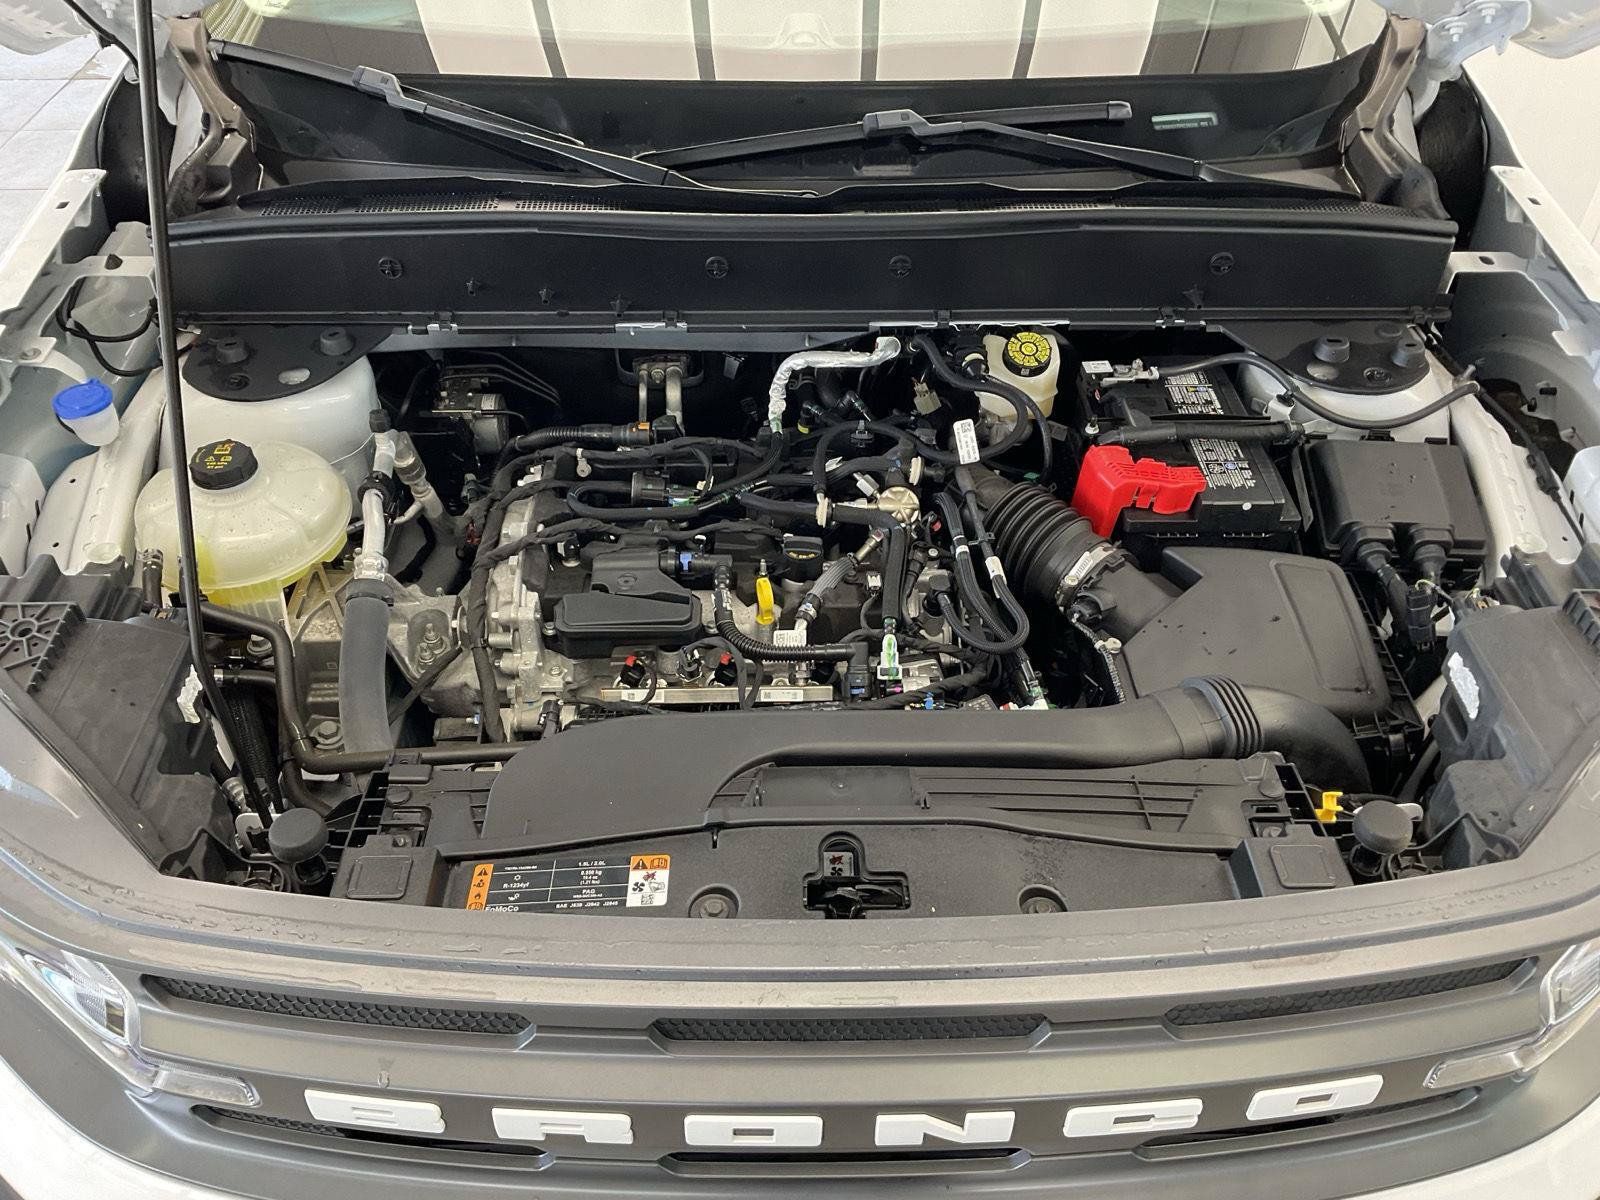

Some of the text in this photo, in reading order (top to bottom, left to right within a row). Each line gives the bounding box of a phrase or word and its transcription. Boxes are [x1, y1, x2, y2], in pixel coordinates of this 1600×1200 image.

[502, 881, 530, 889] R-1234yf
[484, 904, 519, 912] FoMoCo
[304, 1074, 1384, 1147] BRONCO
